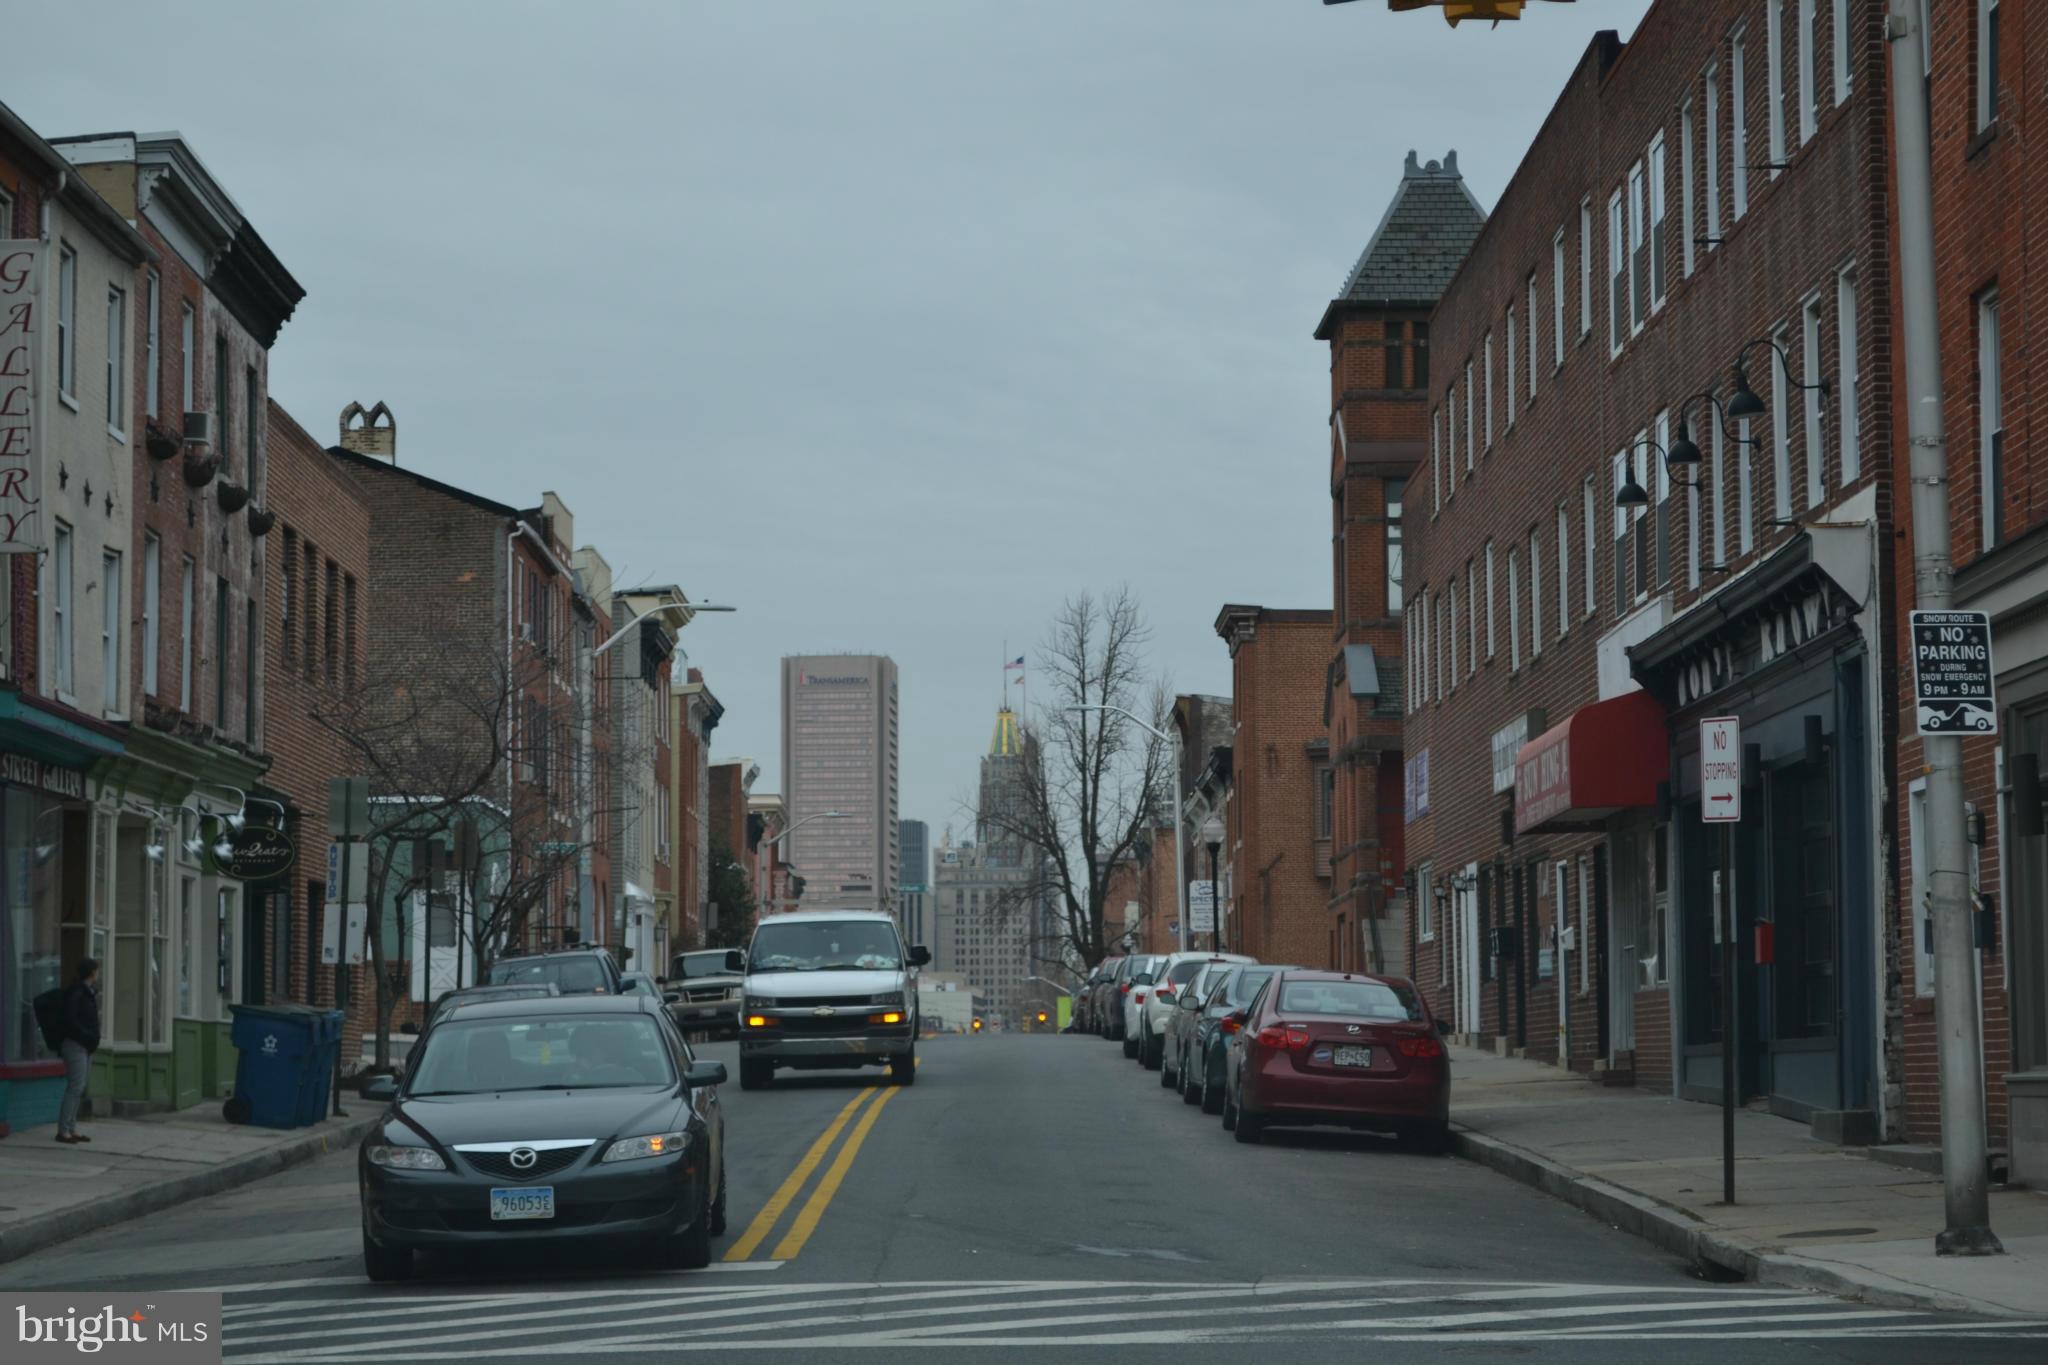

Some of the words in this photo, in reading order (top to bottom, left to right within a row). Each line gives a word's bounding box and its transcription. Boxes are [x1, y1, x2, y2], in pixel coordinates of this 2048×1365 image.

[0, 252, 40, 542] GALLERY
[1923, 615, 1946, 623] SNOW
[1948, 615, 1974, 623] ROUTE
[1940, 627, 1964, 642] NO
[1919, 645, 1986, 660] PARKING
[1940, 663, 1967, 672] DURING
[1921, 673, 1941, 681] SNOW
[1944, 673, 1986, 681] EMERGENCY
[1923, 683, 1932, 695] 9
[1933, 686, 1948, 694] PM
[1960, 682, 1969, 695] 9
[1970, 685, 1985, 694] AM
[1713, 730, 1727, 750] NO
[1, 752, 38, 786] STREET
[43, 764, 81, 798] GALLERY
[1704, 762, 1737, 780] STOPPING
